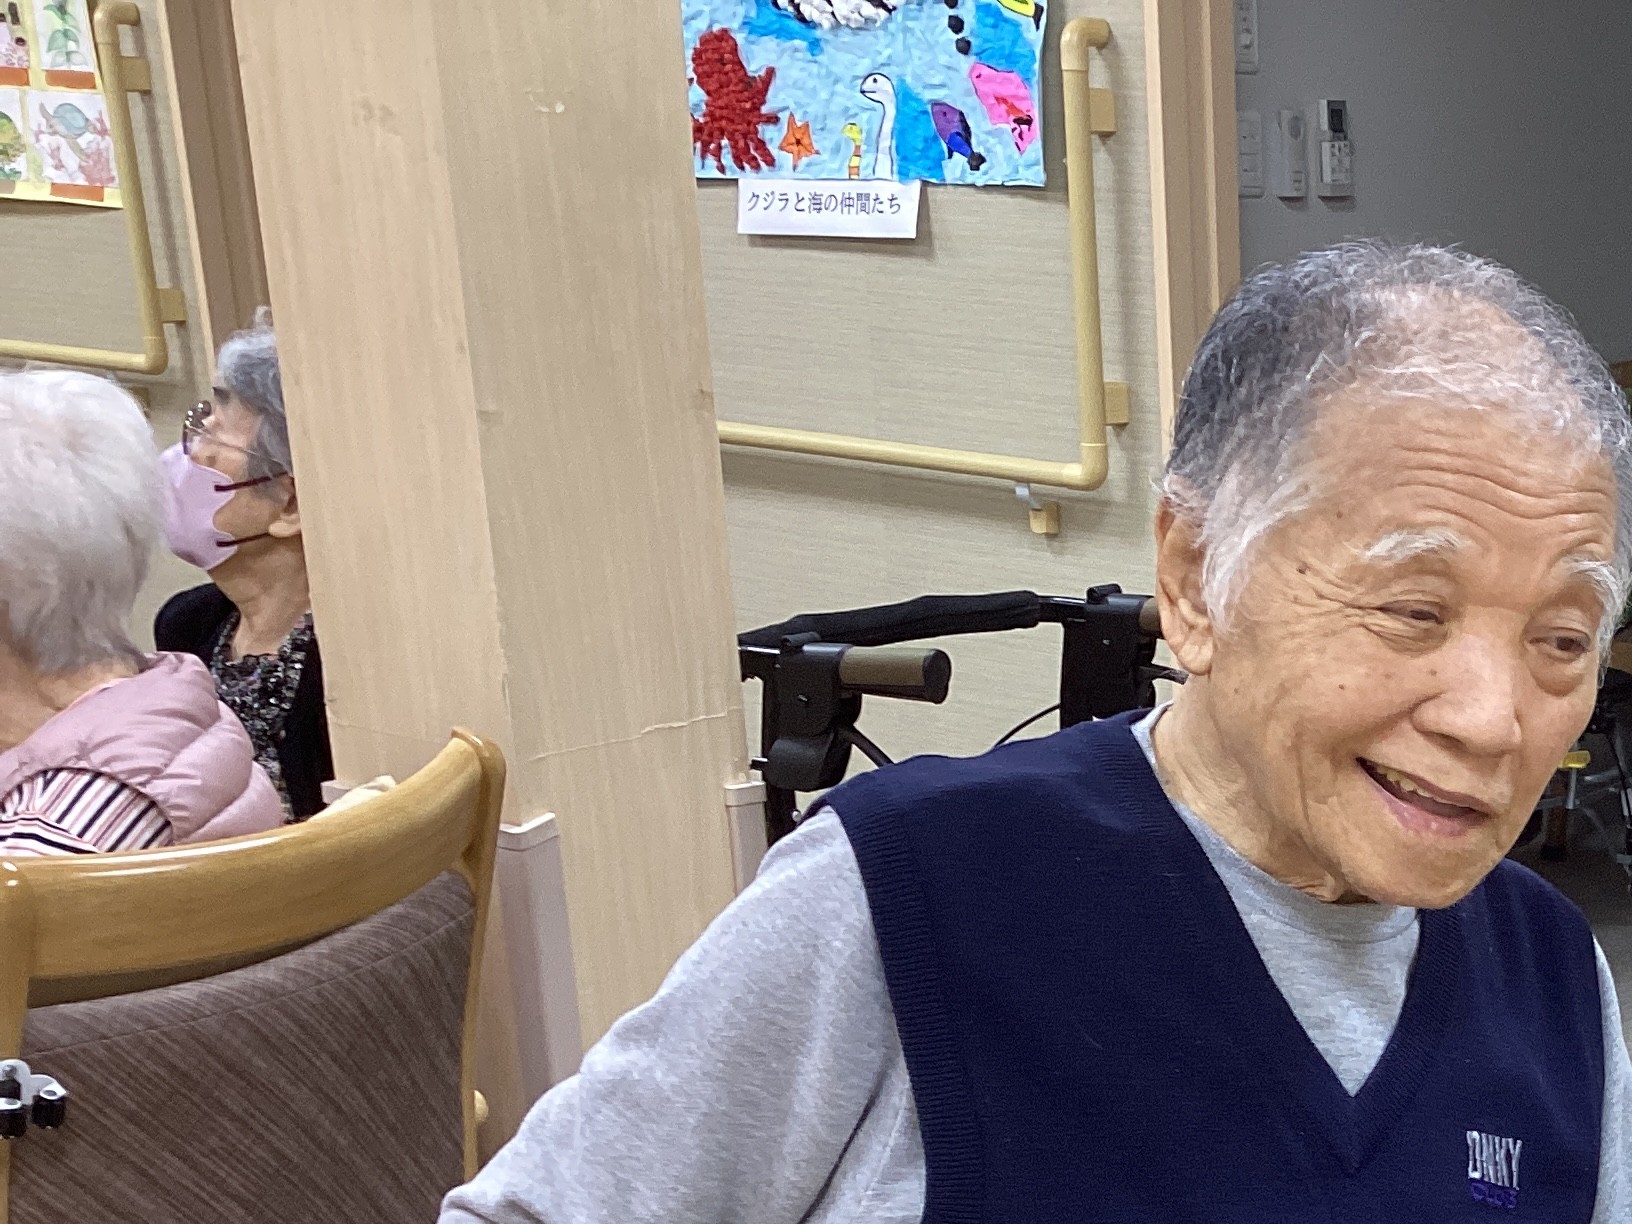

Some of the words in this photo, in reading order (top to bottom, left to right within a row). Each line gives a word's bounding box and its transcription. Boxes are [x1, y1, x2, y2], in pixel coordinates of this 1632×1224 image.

[747, 190, 901, 215] クジラと海の仲間たち
